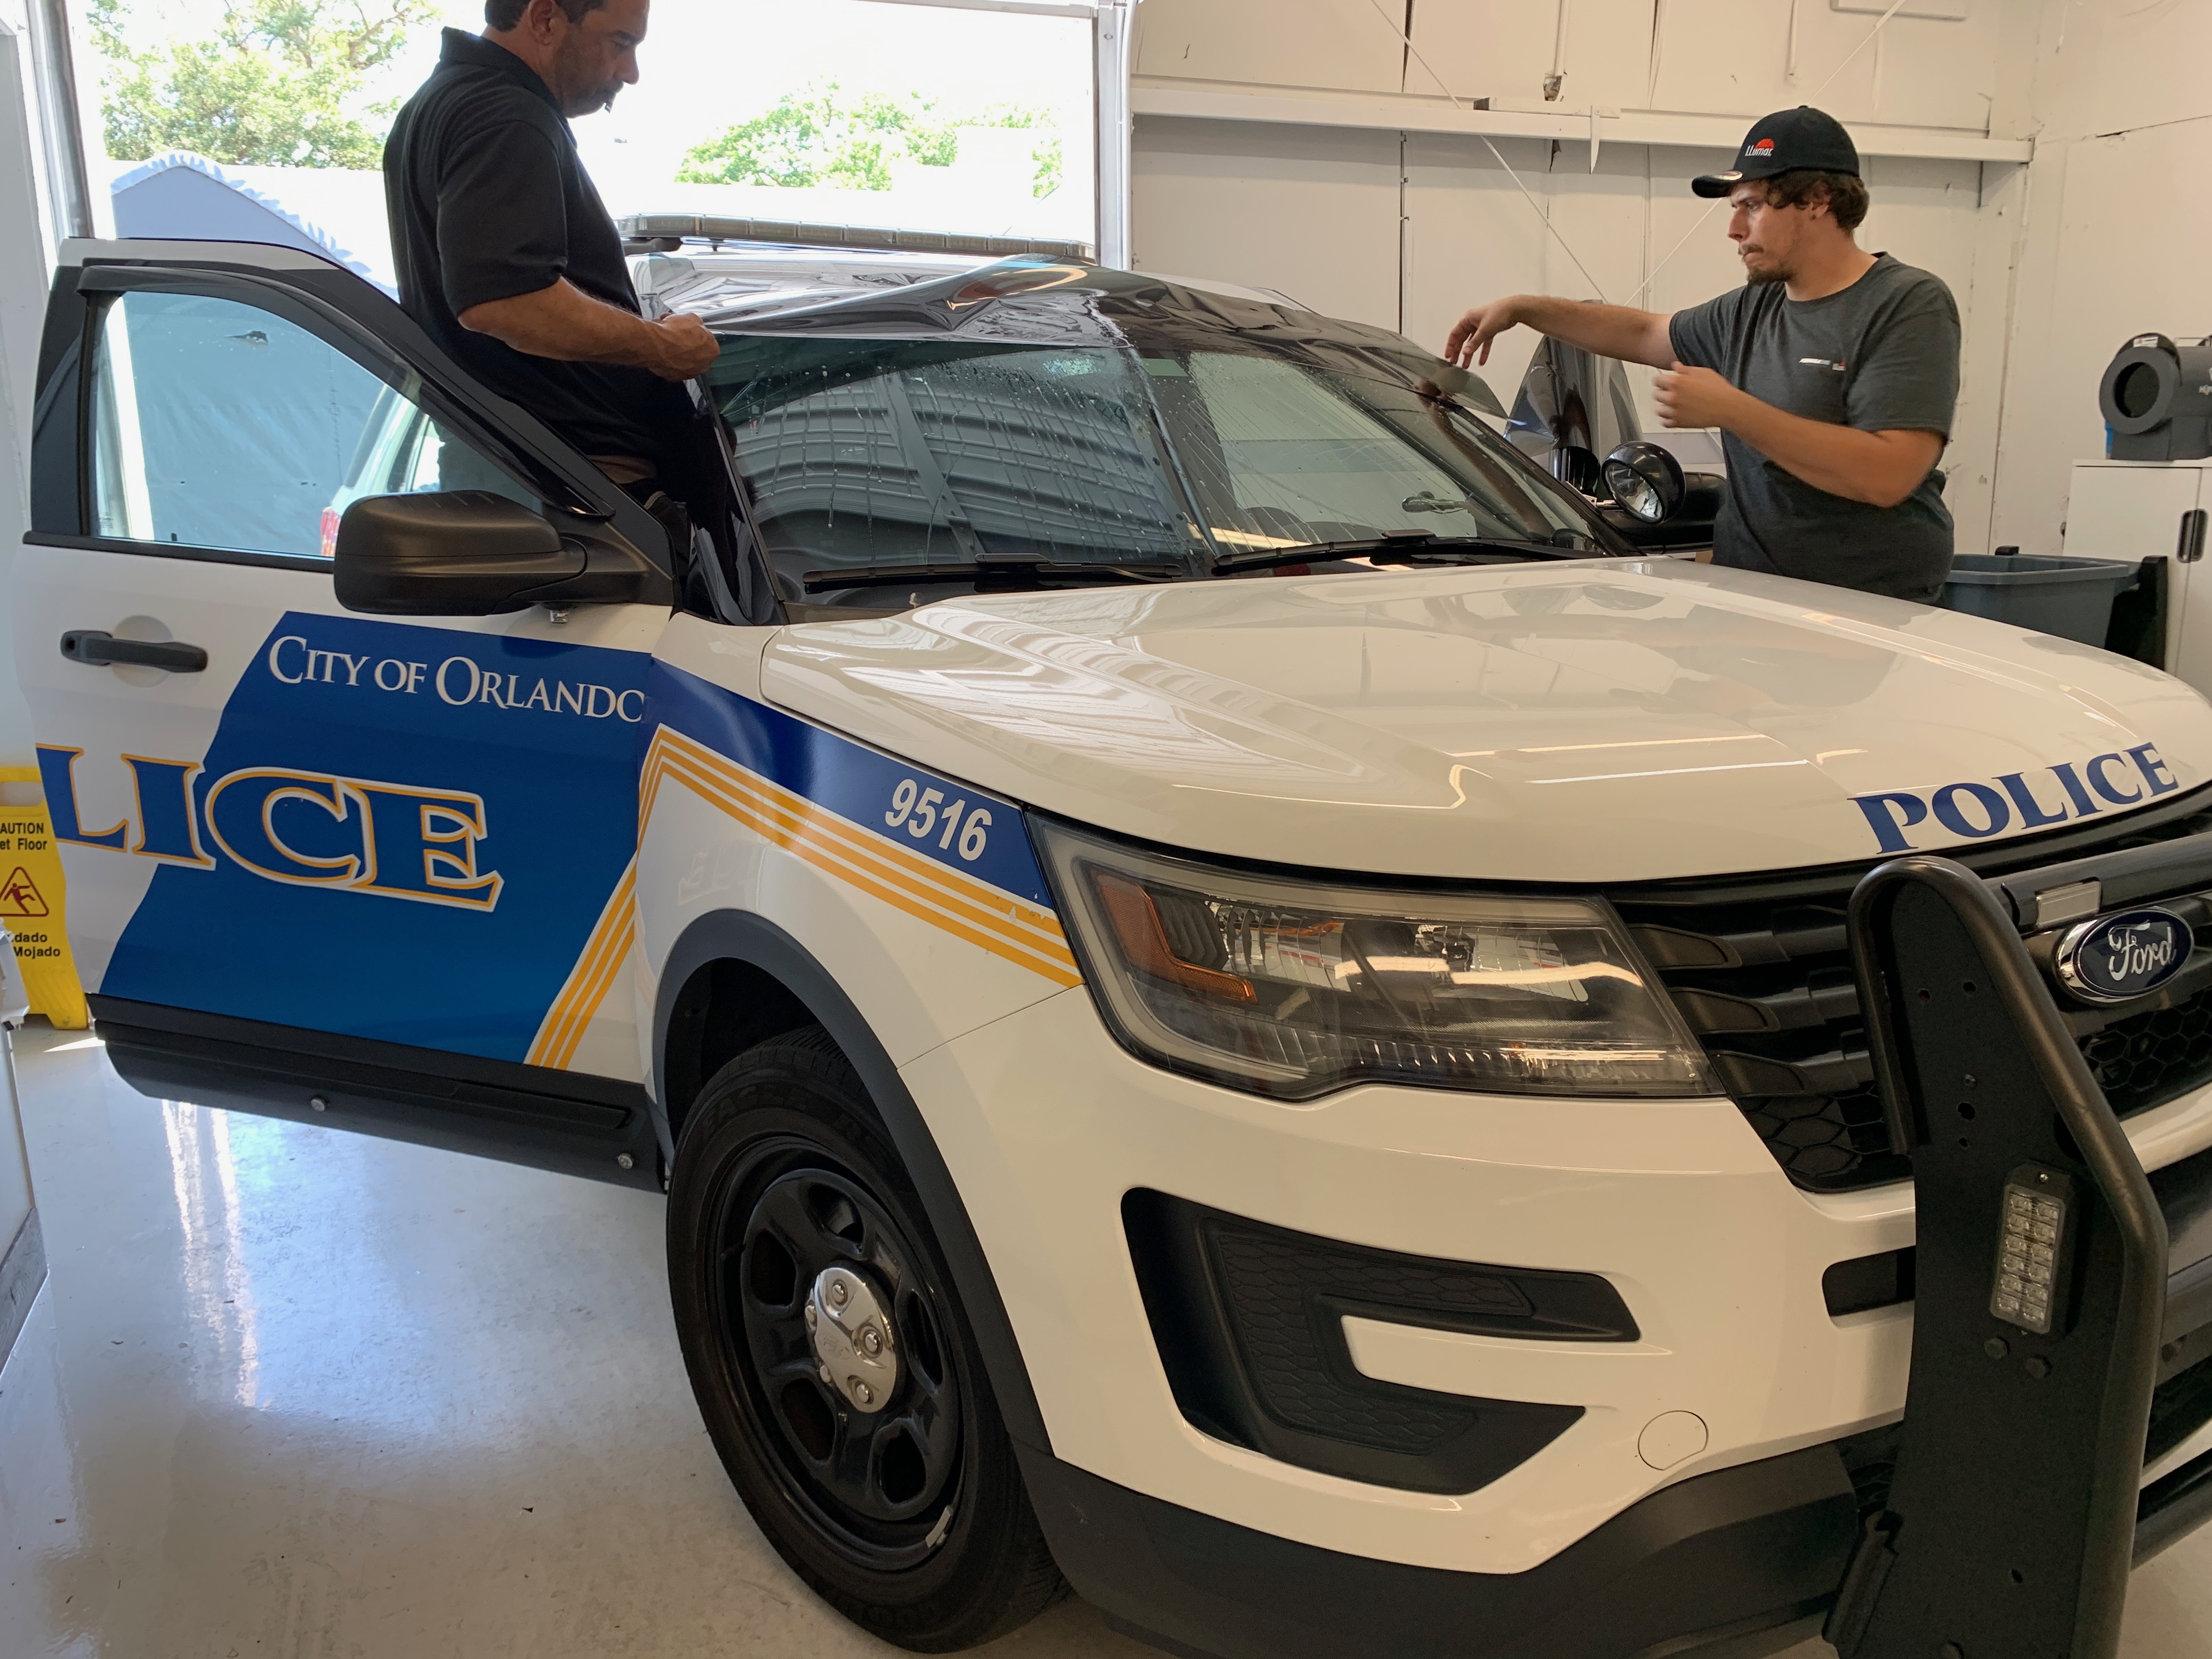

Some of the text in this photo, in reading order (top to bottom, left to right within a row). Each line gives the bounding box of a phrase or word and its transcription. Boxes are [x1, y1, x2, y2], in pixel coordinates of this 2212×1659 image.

[268, 635, 370, 687] CITY
[374, 659, 428, 695] OF
[35, 743, 504, 912] LICE
[885, 778, 992, 861] 9516
[1847, 741, 2180, 855] POLICE
[18, 838, 48, 850] Floor
[11, 932, 48, 943] dado
[2108, 920, 2177, 981] Ford
